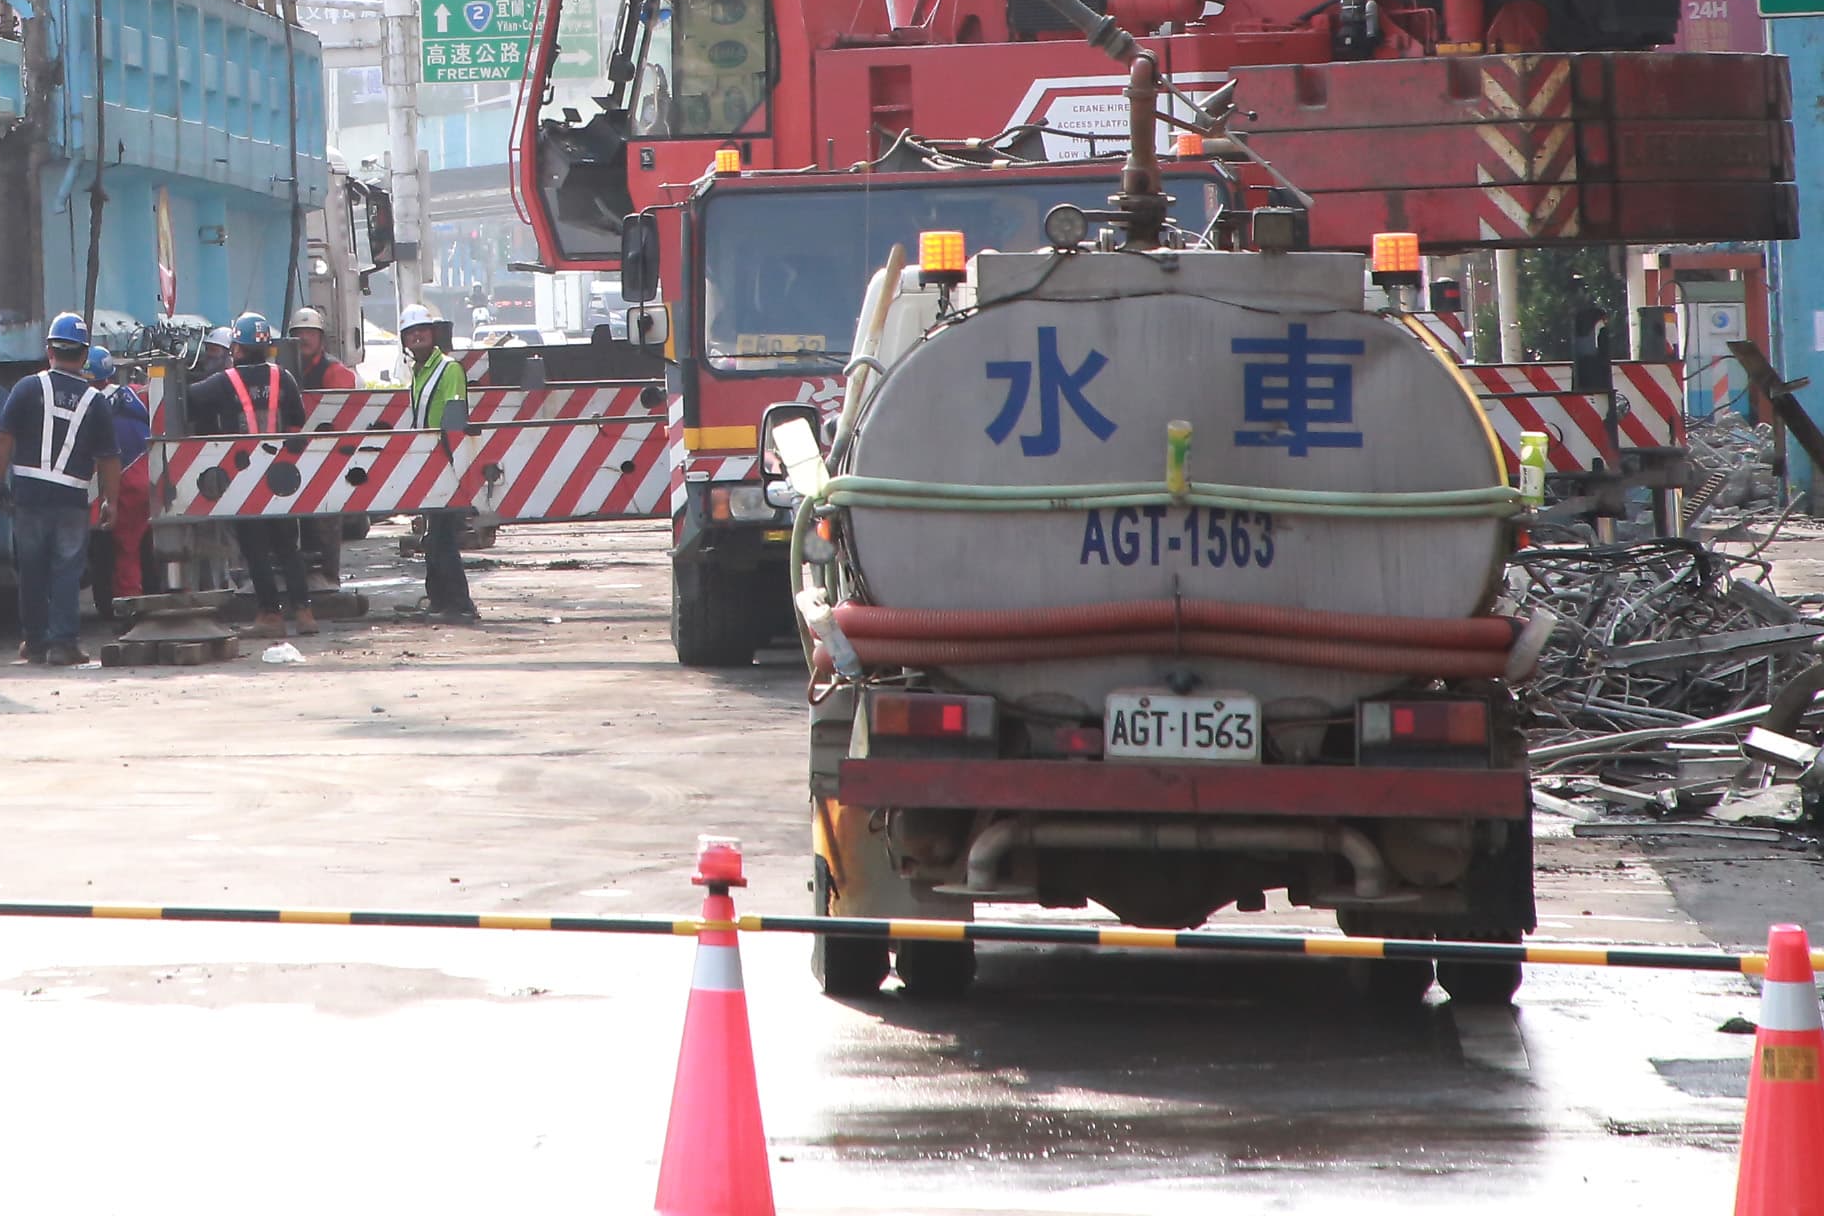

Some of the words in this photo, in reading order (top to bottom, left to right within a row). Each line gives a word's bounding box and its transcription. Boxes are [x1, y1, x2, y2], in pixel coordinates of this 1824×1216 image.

[473, 5, 485, 20] 2
[1688, 0, 1728, 20] 24H
[426, 42, 520, 65] 高速公路
[437, 67, 511, 80] FREEWAY
[1073, 104, 1105, 113] CRANE
[1108, 103, 1130, 112] HIRE
[1058, 120, 1093, 129] ACCESS
[1095, 119, 1129, 128] PLATFO
[1059, 151, 1079, 159] LOW
[985, 323, 1366, 458] 水車
[1079, 511, 1275, 569] AGT-1563
[1110, 709, 1254, 749] AGT-1563
